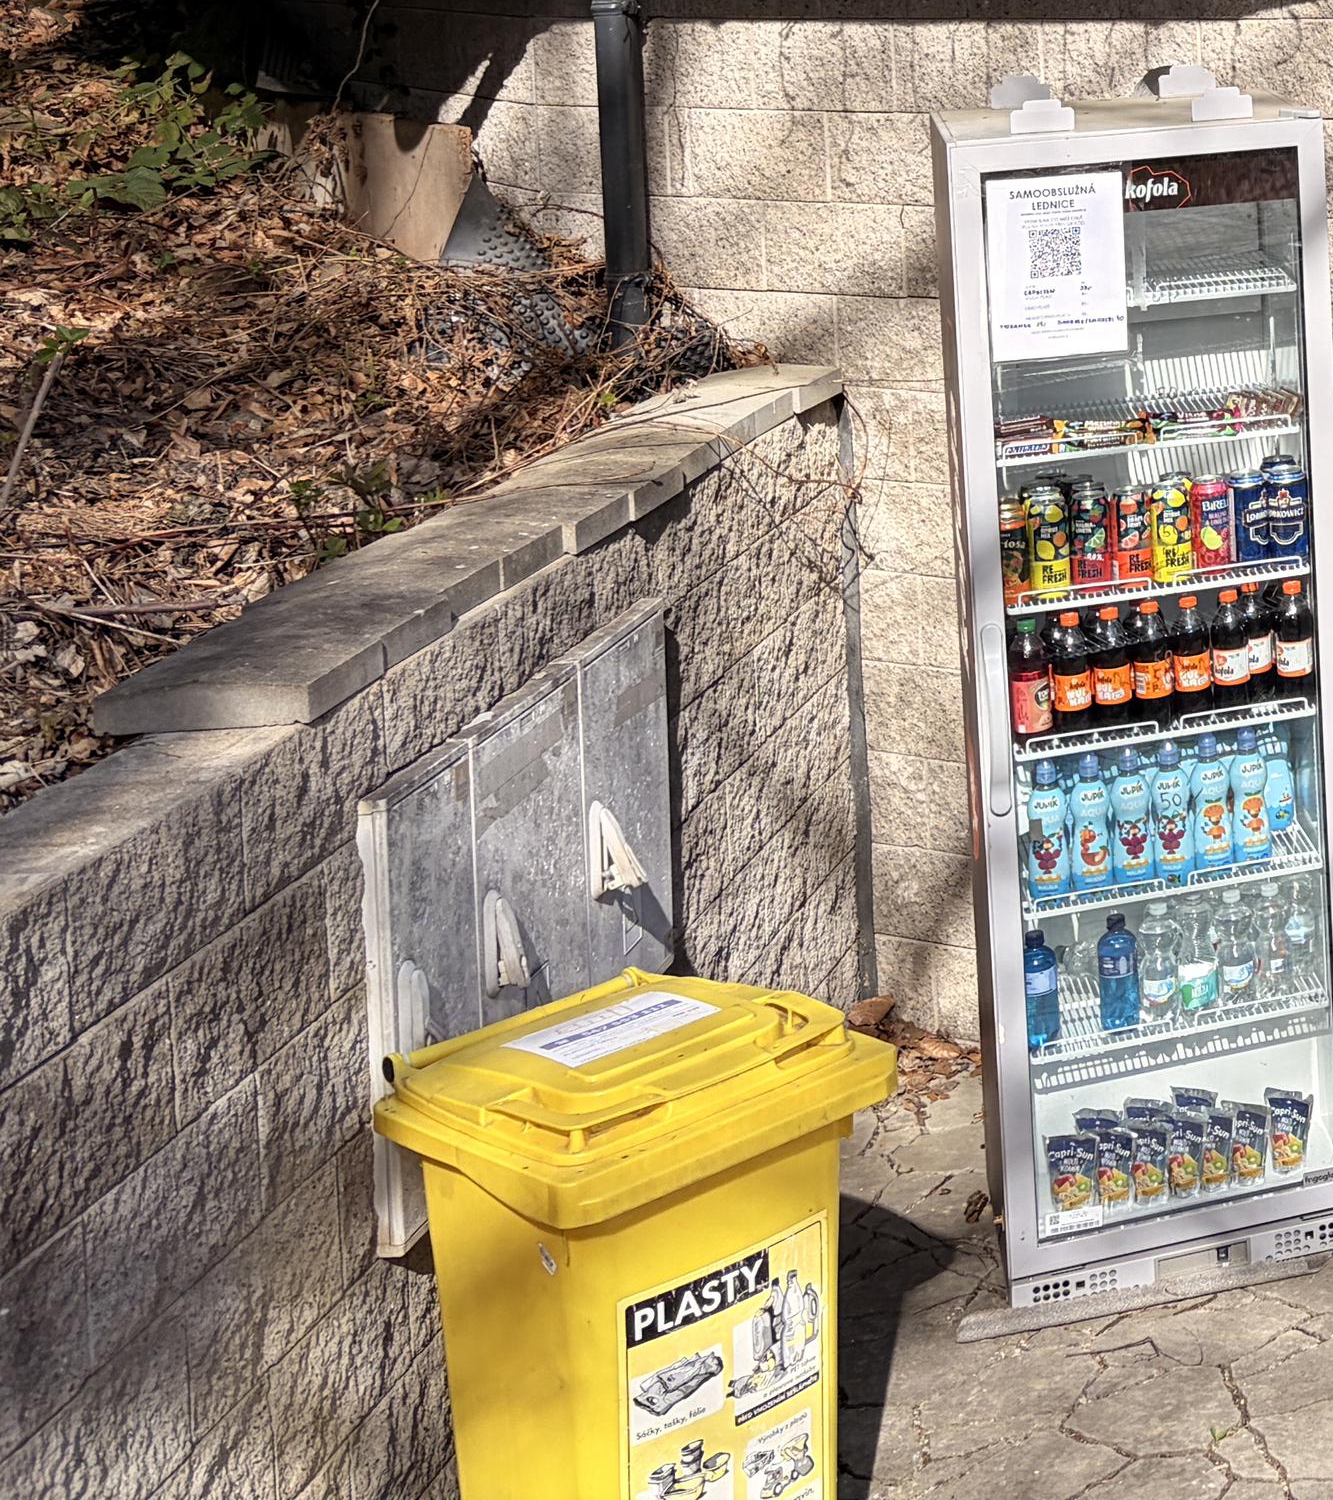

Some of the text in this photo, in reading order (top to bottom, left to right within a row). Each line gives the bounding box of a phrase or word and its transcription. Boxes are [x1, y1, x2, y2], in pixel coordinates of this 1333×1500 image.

[1009, 183, 1096, 199] SAMOOBSLUŽNÁ
[1125, 177, 1179, 203] kofola
[1031, 199, 1075, 211] LEDNICE
[1129, 554, 1141, 563] RE
[1165, 556, 1190, 569] FRESH
[1042, 565, 1054, 575] RE
[1078, 568, 1103, 579] FRESH
[1042, 571, 1067, 585] FRESH
[1271, 1106, 1306, 1124] Capri-Sun
[1047, 1146, 1094, 1162] Capri-Sun
[632, 1257, 764, 1342] PLASTY
[663, 1411, 688, 1431] tašky,
